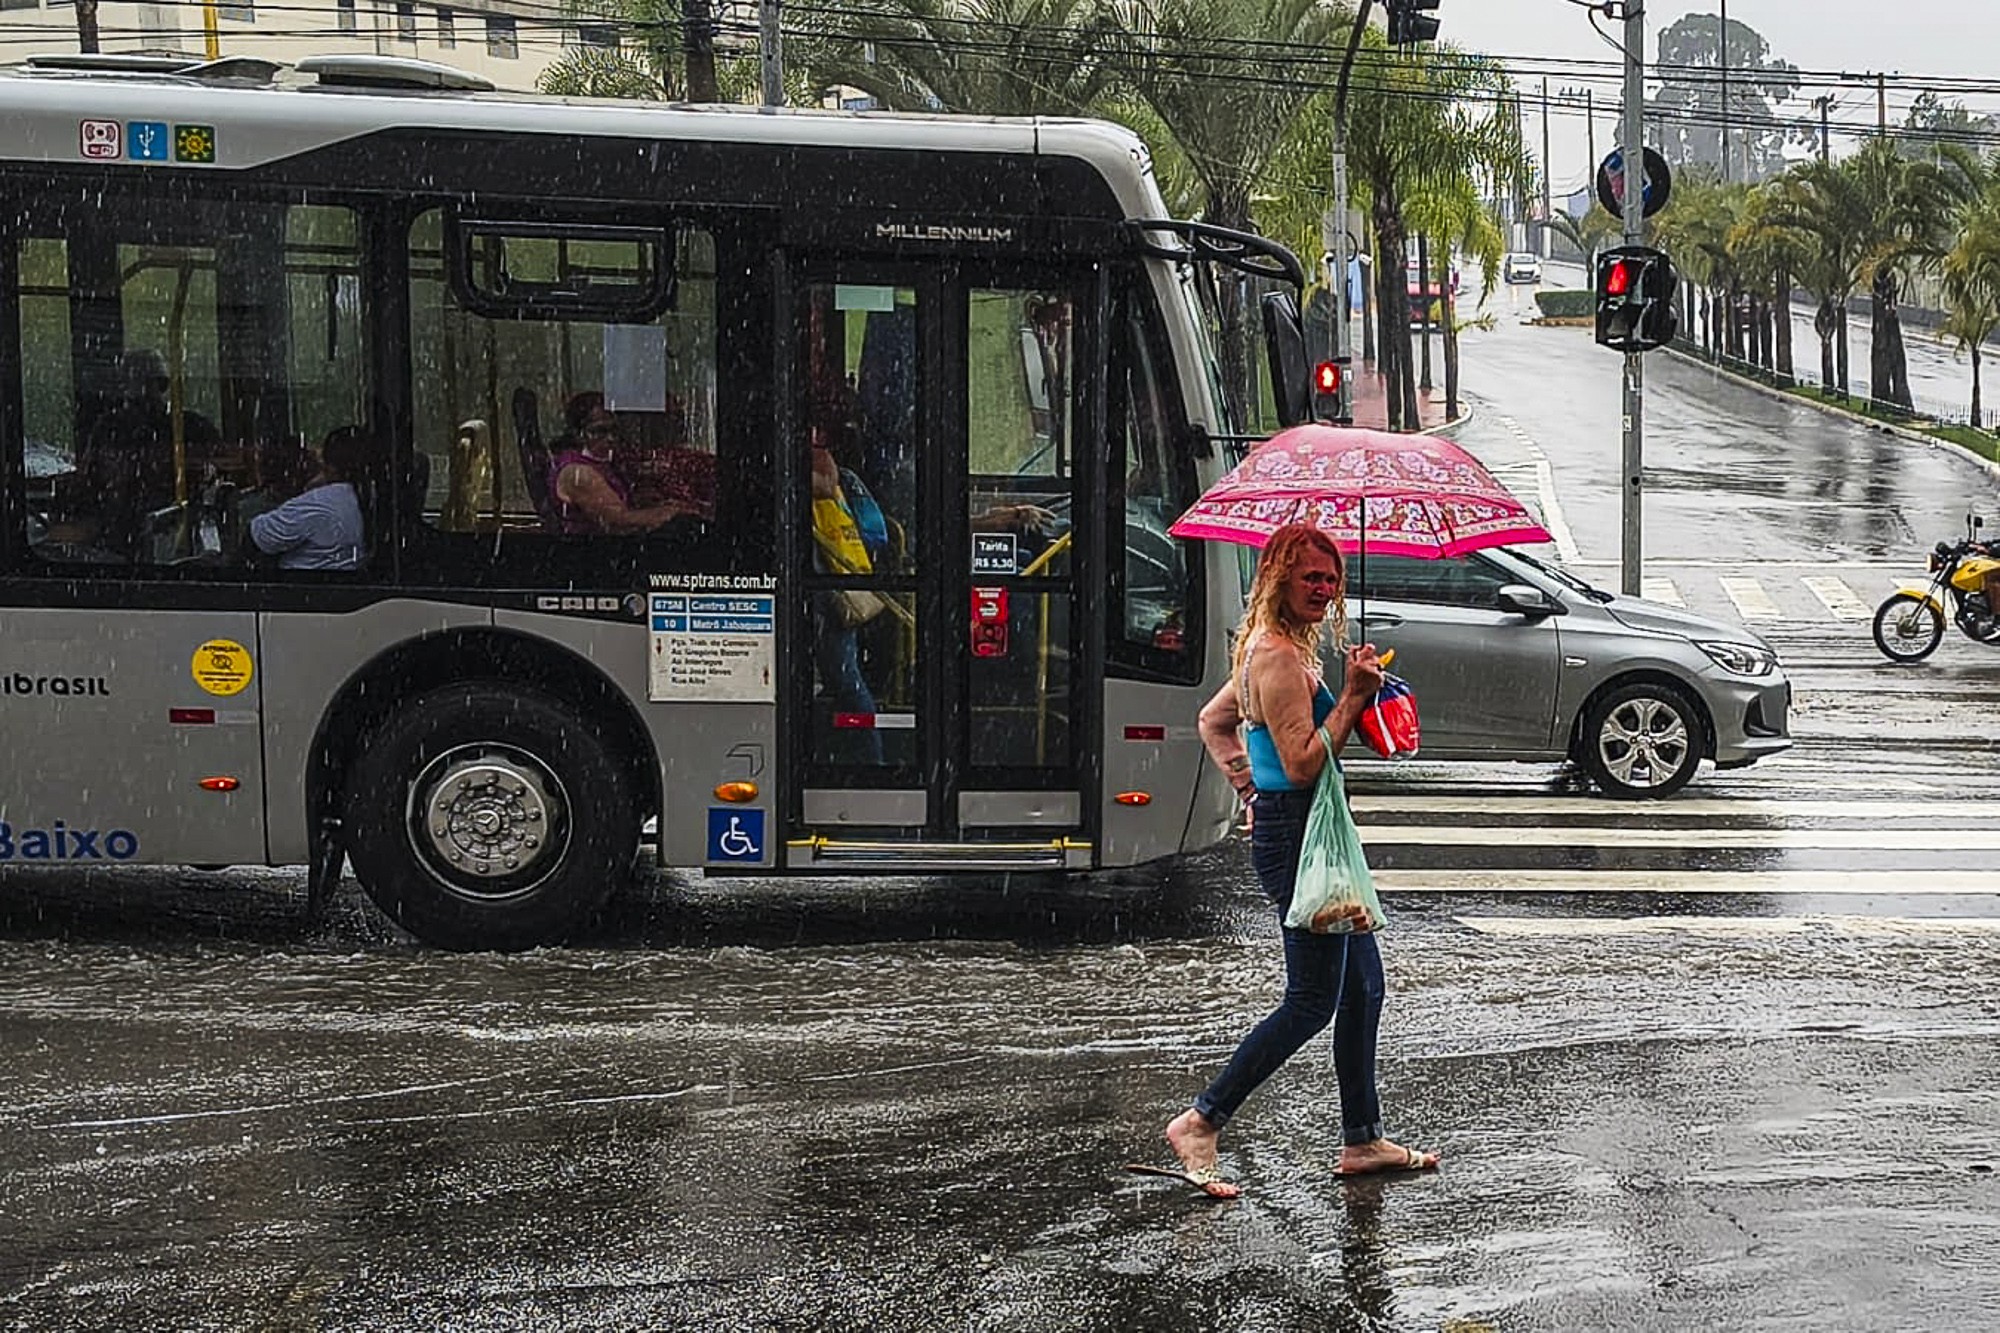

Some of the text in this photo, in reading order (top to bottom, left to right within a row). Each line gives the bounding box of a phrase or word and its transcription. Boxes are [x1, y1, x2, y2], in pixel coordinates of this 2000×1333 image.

[876, 224, 1012, 241] MILLENNIUM
[979, 541, 1009, 552] Tarifa
[649, 572, 777, 591] www.sptrans.com.br
[537, 596, 619, 610] CAIO
[691, 601, 758, 612] Centro SESC
[664, 619, 677, 628] 10
